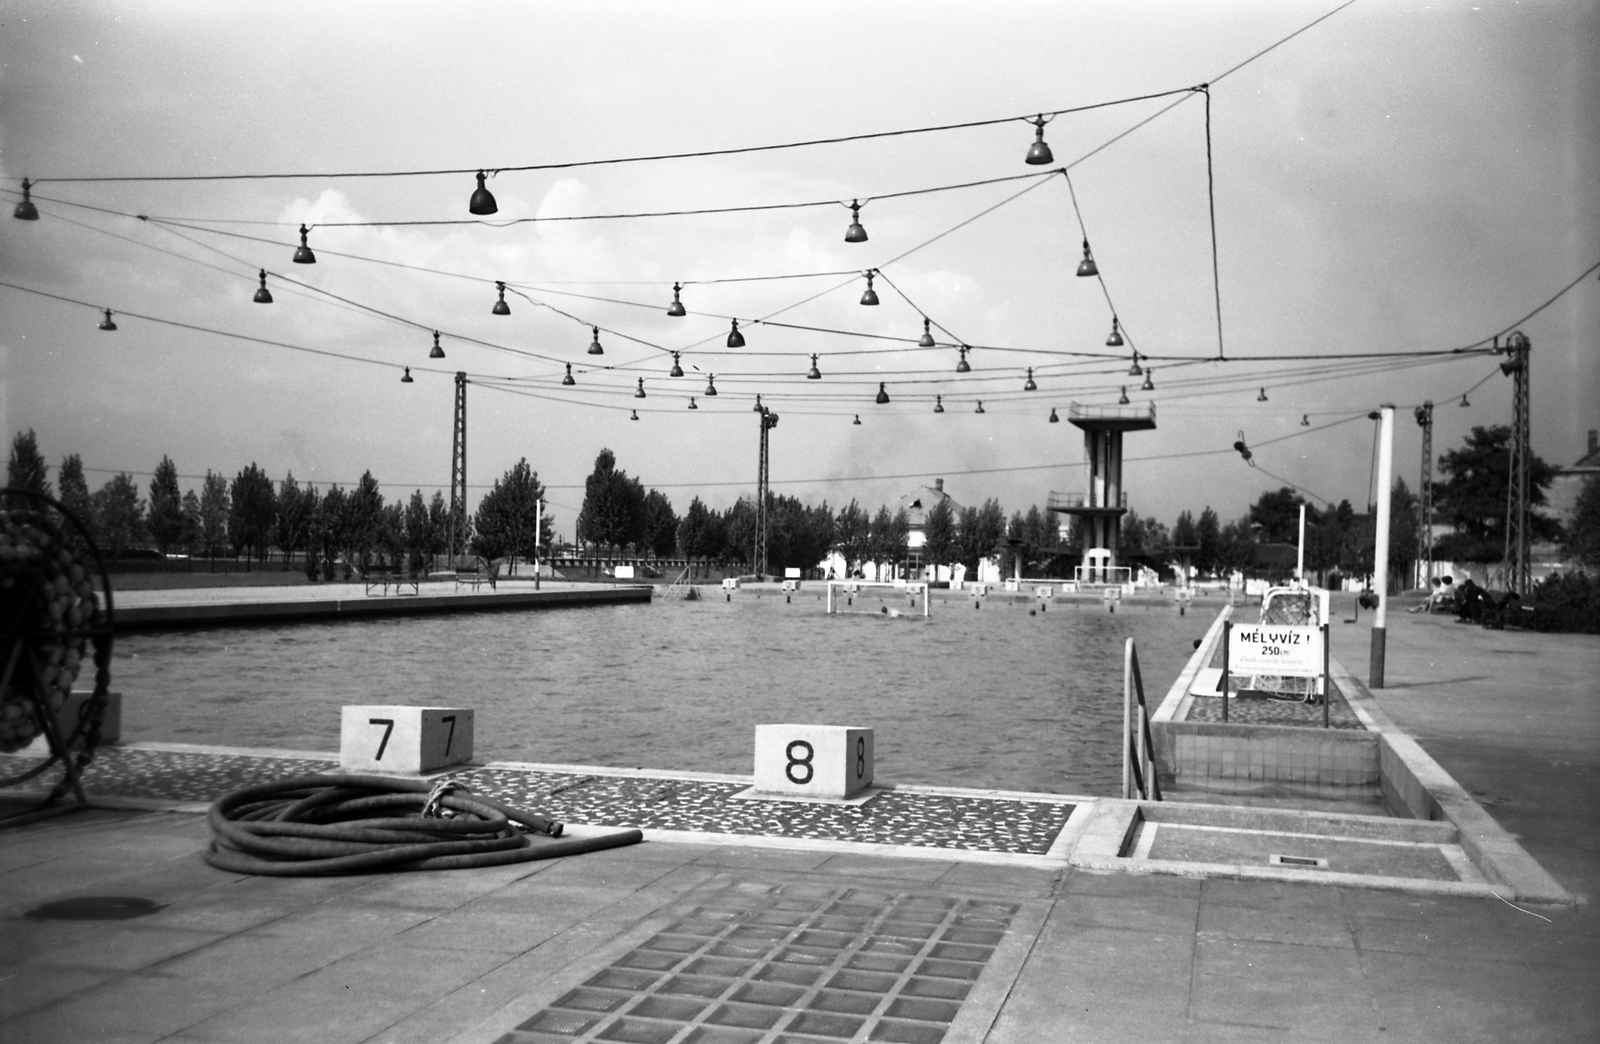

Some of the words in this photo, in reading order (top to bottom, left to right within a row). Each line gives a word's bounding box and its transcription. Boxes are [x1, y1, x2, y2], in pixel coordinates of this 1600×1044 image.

[1240, 628, 1301, 645] MÉLYVÍZ
[1306, 634, 1310, 645] !
[368, 718, 394, 761] 7
[441, 714, 456, 757] 7
[785, 739, 814, 785] 8
[856, 736, 865, 780] 8
